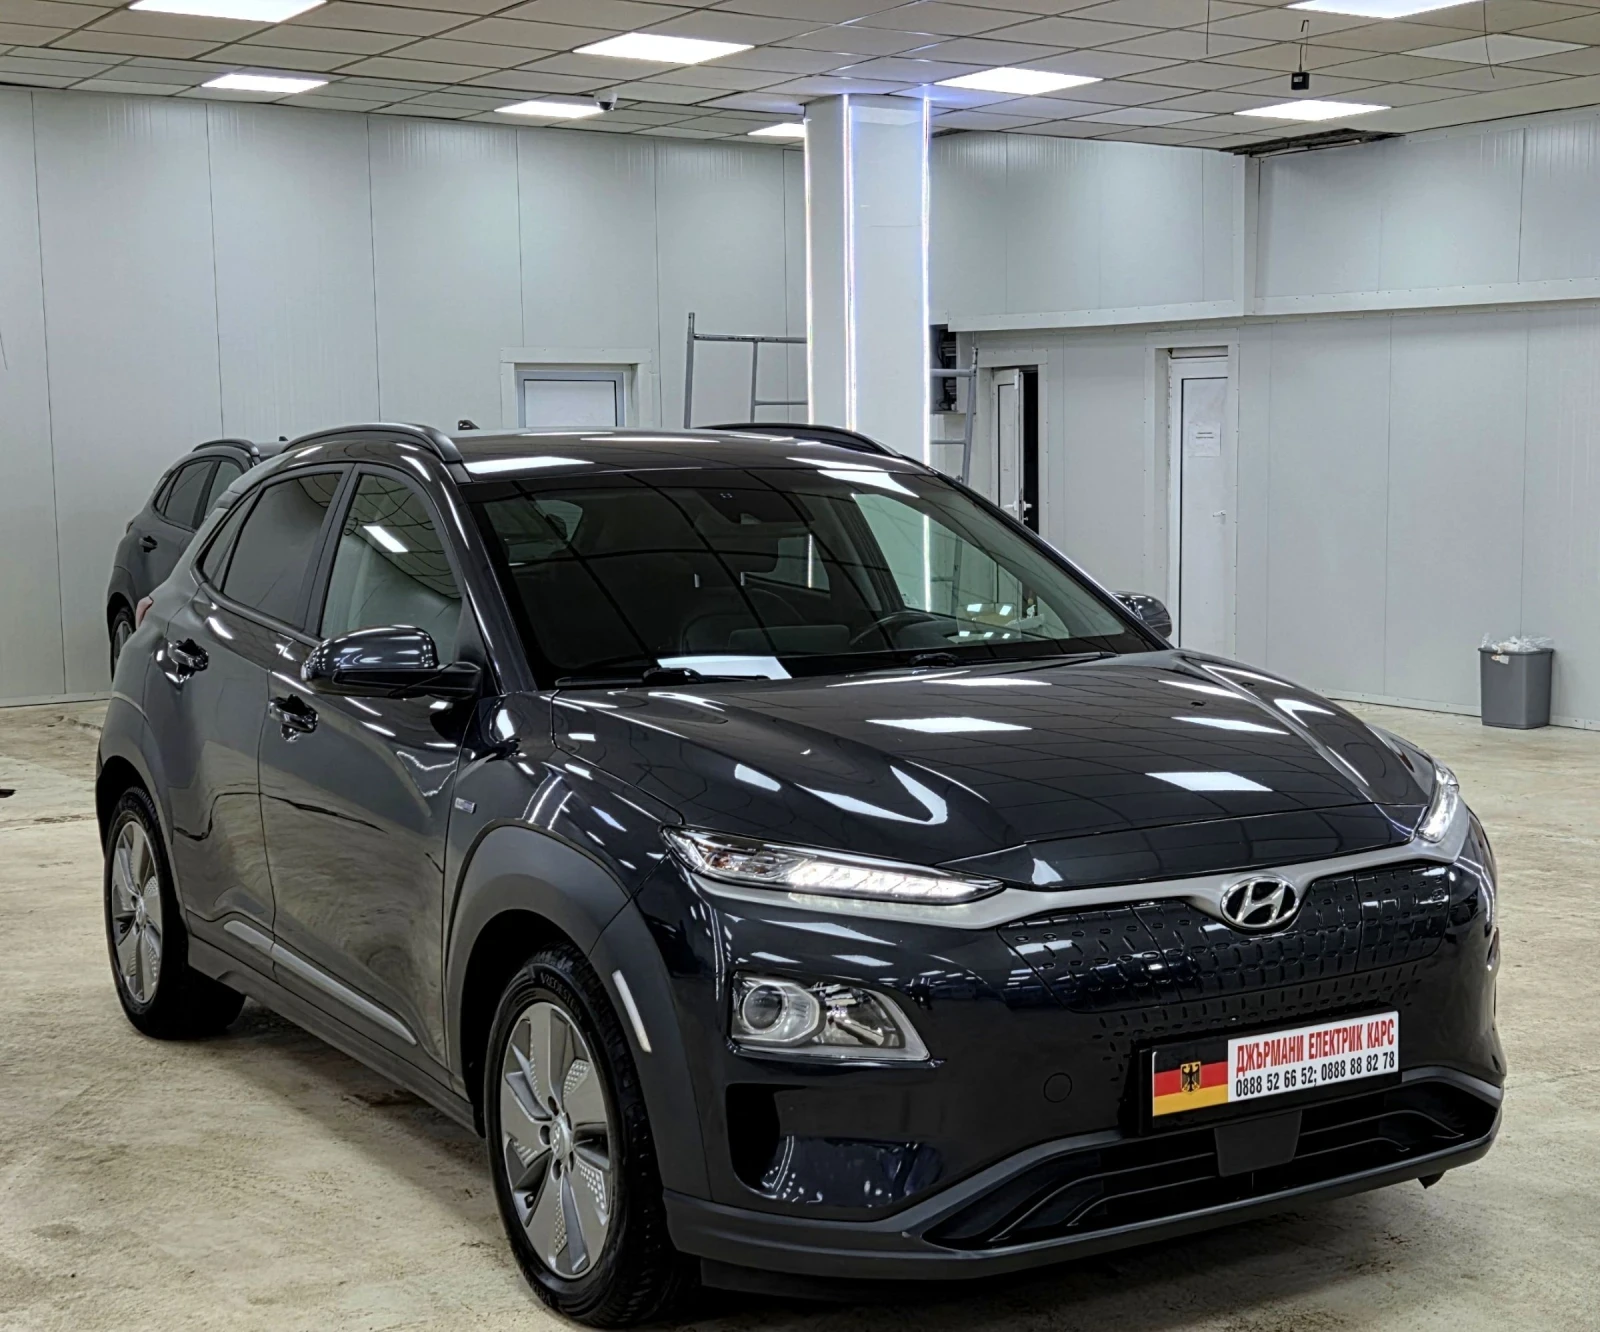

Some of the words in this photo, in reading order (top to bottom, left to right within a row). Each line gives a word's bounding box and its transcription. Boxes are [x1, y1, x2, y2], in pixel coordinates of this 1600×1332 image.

[1236, 1035, 1304, 1078] ДЖЪРМАНИ
[1309, 1024, 1363, 1060] ЕЛЕКТРИК
[1367, 1018, 1395, 1049] КАРС
[1236, 1075, 1262, 1098] 0888
[1266, 1072, 1280, 1093] 52
[1284, 1069, 1297, 1090] 66
[1301, 1065, 1317, 1087] 52;
[1321, 1059, 1346, 1081] 0888
[1350, 1056, 1362, 1076] 88
[1366, 1054, 1379, 1073] 82
[1383, 1050, 1395, 1070] 78
